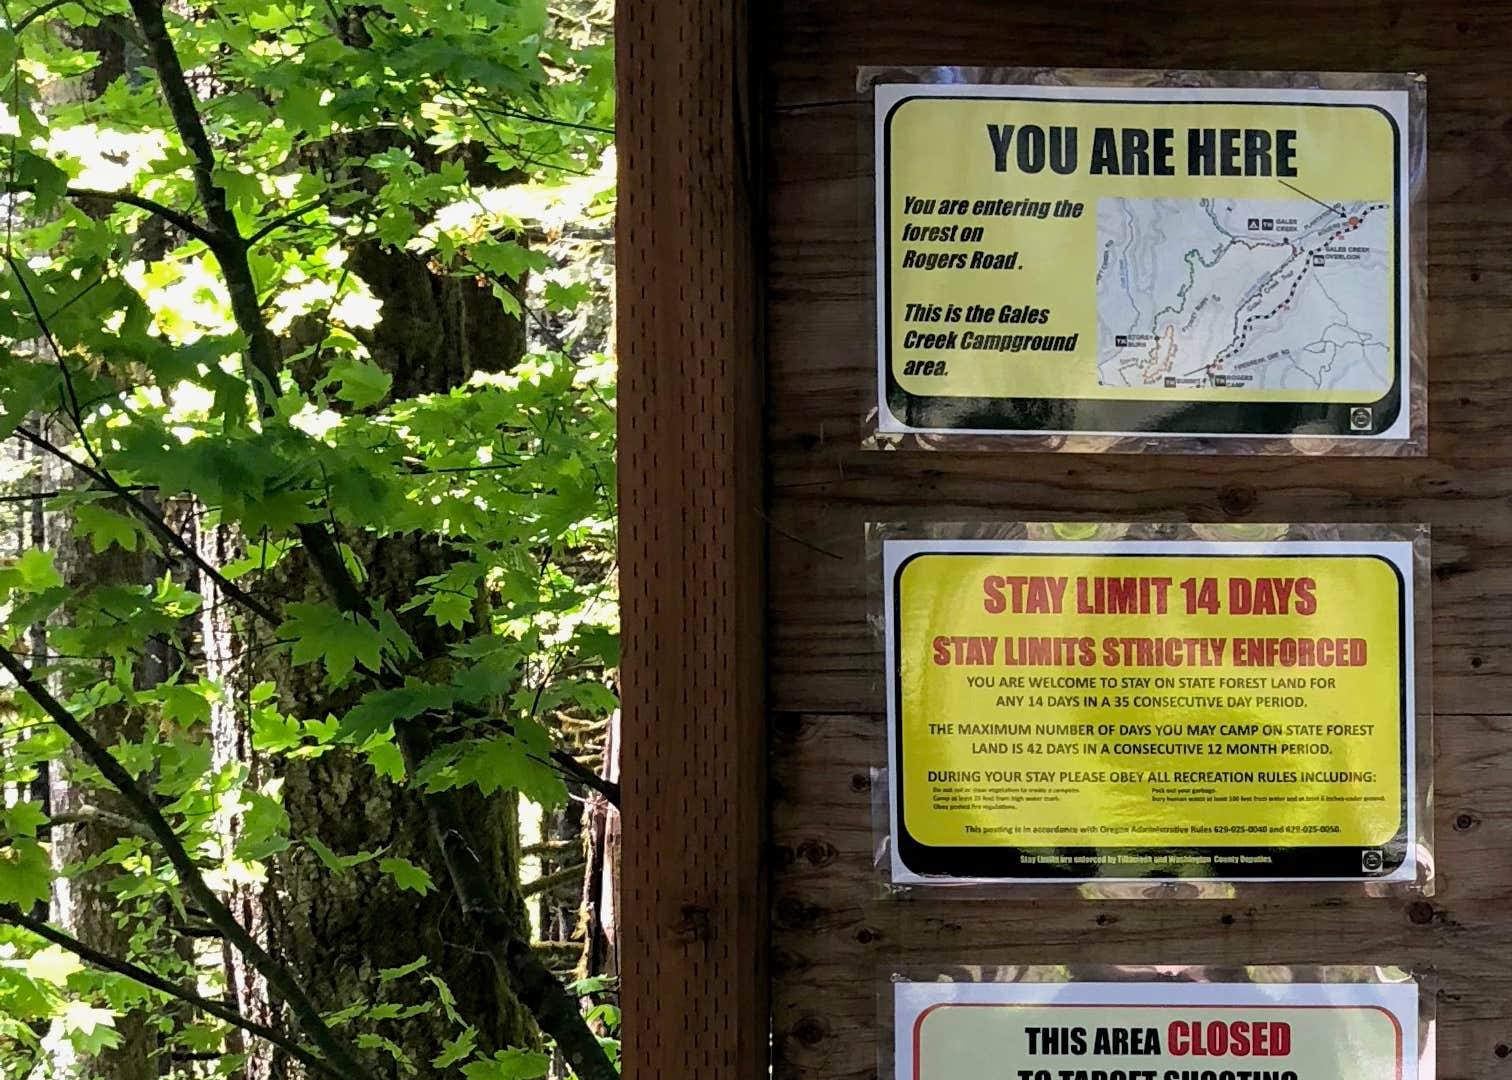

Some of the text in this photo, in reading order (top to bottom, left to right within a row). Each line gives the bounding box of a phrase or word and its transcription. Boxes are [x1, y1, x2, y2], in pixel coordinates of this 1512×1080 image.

[986, 124, 1297, 177] YOU ARE HERE
[903, 196, 1084, 219] You are entering the
[901, 222, 984, 242] forest on
[902, 249, 968, 271] Rogers
[903, 304, 1050, 324] This is the Gales
[903, 330, 1079, 353] Creek Campground
[902, 360, 948, 376] area.
[983, 575, 1317, 616] STAY LIMIT 14 DAYS
[932, 636, 1367, 667] STAY LIMITS STRICTLY ENFORCED
[966, 676, 1336, 689] YOU ARE WELCOME TO STAY ON STATE FOREST LAND FOR
[1024, 1020, 1290, 1056] THIS AREA CLOSED
